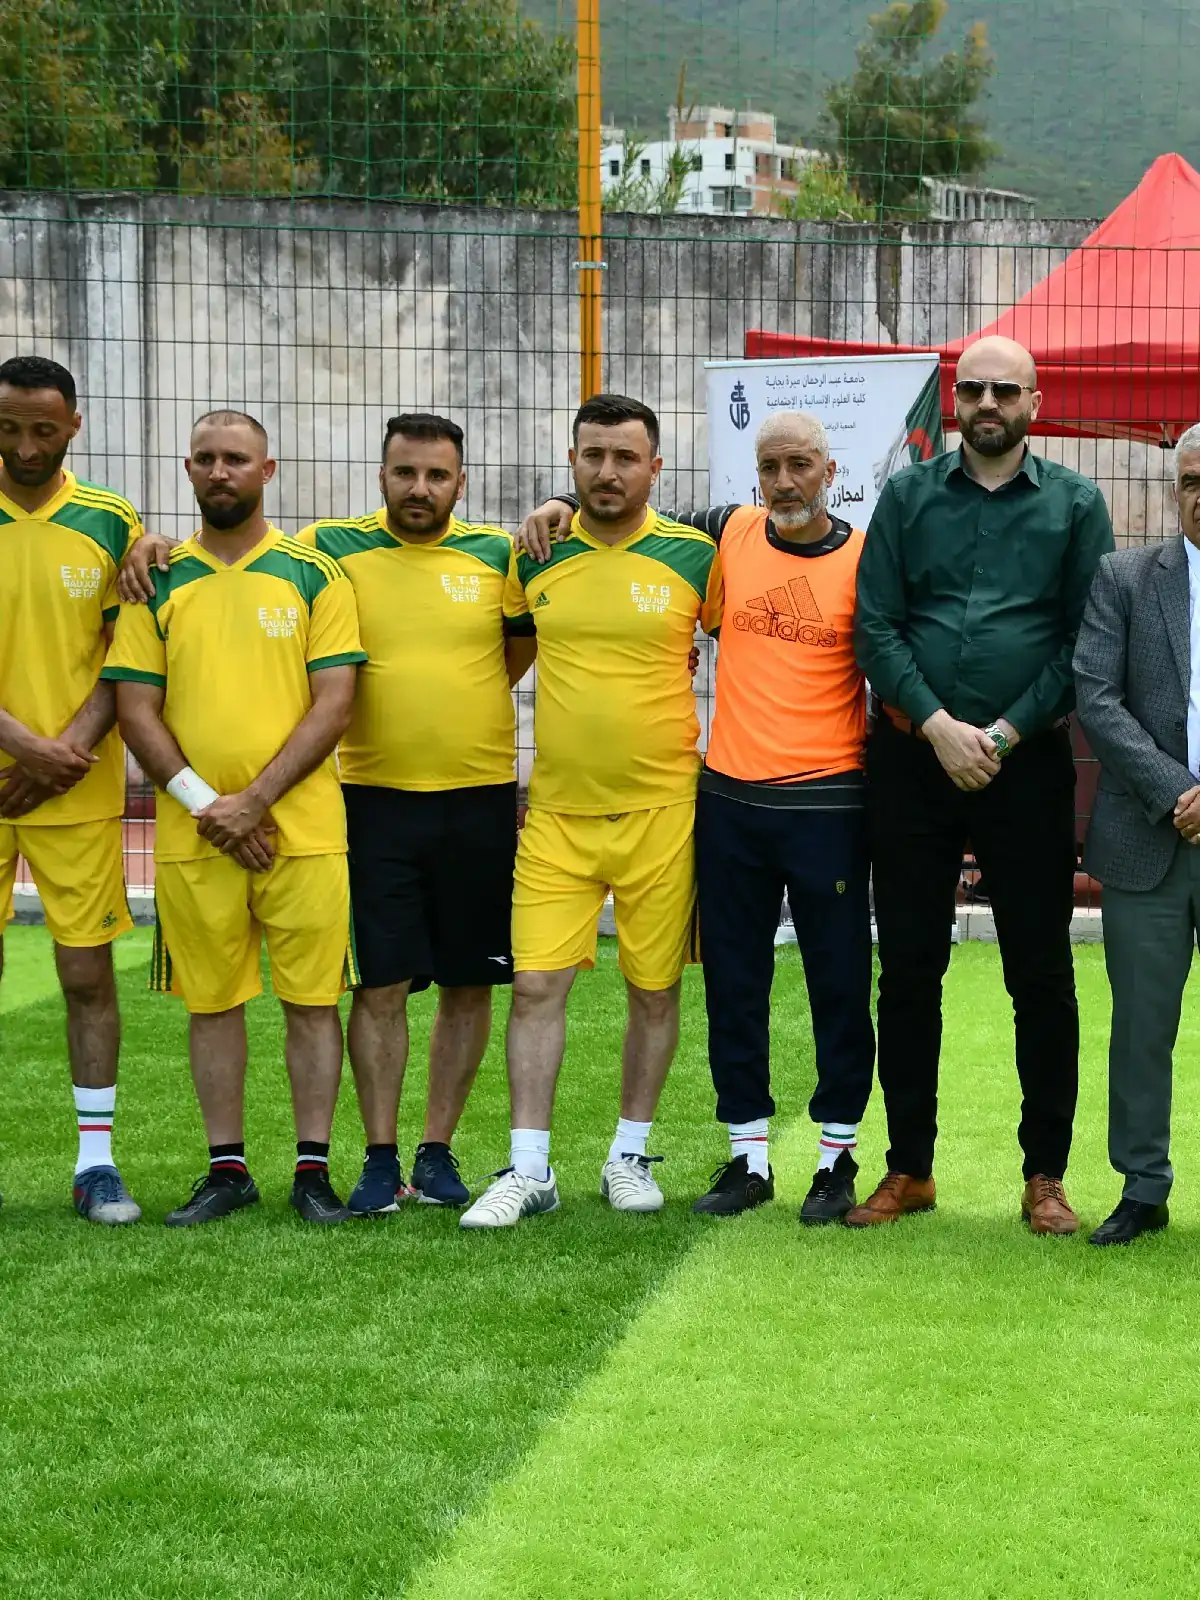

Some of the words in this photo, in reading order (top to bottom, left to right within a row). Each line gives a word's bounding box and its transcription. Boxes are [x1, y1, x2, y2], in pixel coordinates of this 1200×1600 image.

[765, 375, 785, 390] بجاية
[785, 374, 800, 389] ميرة
[802, 373, 827, 388] الرحمان
[828, 376, 842, 388] عبد
[844, 372, 866, 386] جامعة
[832, 392, 851, 408] العلوم
[852, 392, 867, 407] كلية
[830, 484, 864, 509] لمجازر
[61, 564, 101, 581] E.T.B
[441, 574, 480, 587] E.T.B
[68, 588, 96, 599] SETIF
[630, 582, 670, 598] E.T.B
[451, 594, 479, 603] SETIF
[258, 607, 298, 621] E.T.B
[637, 603, 666, 615] SETIF
[266, 628, 294, 638] SETIF
[733, 610, 838, 648] adidas
